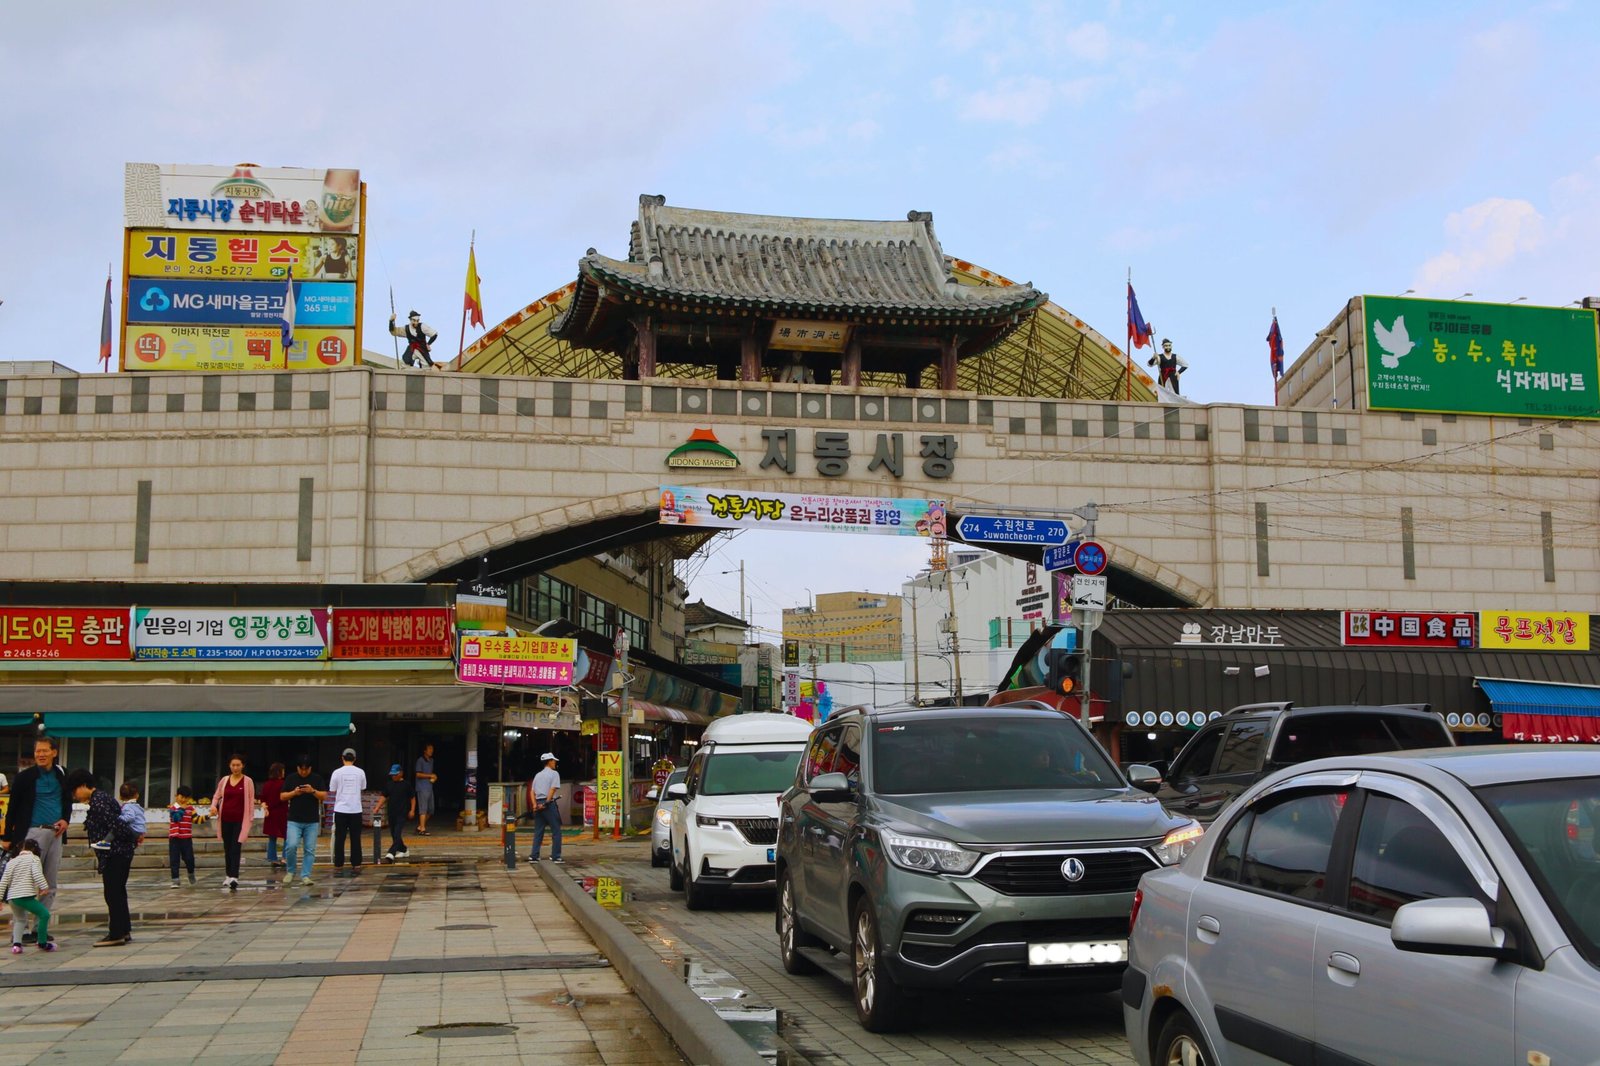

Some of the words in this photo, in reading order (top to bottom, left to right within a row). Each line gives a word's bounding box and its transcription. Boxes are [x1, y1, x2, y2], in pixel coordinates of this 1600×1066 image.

[225, 186, 262, 197] 지동시장
[168, 197, 235, 222] 지동시장
[239, 200, 303, 224] 순대타운
[144, 236, 299, 263] 지동헬스
[164, 265, 181, 273] 문의
[189, 264, 253, 276] 243-5272
[271, 267, 286, 276] 2F
[304, 304, 320, 312] 365
[171, 328, 199, 337] 이바지
[202, 328, 230, 338] 떡전문
[138, 337, 160, 359] 떡
[320, 340, 341, 362] 떡
[1497, 369, 1585, 393] 식자재마트
[759, 428, 958, 478] 지동시장
[670, 458, 700, 467] JIDONG
[702, 459, 735, 467] MARKET
[707, 494, 785, 520] 전통시장
[790, 505, 871, 525] 온누리상품권
[875, 509, 901, 526] 환영
[964, 524, 979, 532] 274
[994, 520, 1035, 531] 수원천로
[984, 531, 1045, 541] Suwoncheon-ro
[1048, 528, 1064, 537] 270
[1076, 578, 1105, 586] 견인지역
[80, 615, 124, 645] 총판
[143, 617, 191, 636] 믿음의
[196, 619, 223, 636] 기업
[229, 615, 314, 639] 영광상회
[338, 616, 379, 641] 중소기업
[382, 616, 413, 641] 박람회
[415, 616, 446, 641] 전시장
[1375, 616, 1471, 638] 中国食品
[1494, 616, 1577, 644] 목포젓갈
[1211, 624, 1282, 645] 장날만두
[14, 649, 60, 657] 248-5246
[206, 649, 242, 657] 235-1500
[484, 640, 558, 654] 우수중소기업매장
[600, 754, 620, 764] TV
[600, 768, 620, 776] 홈쇼핑
[601, 780, 619, 791] 중소
